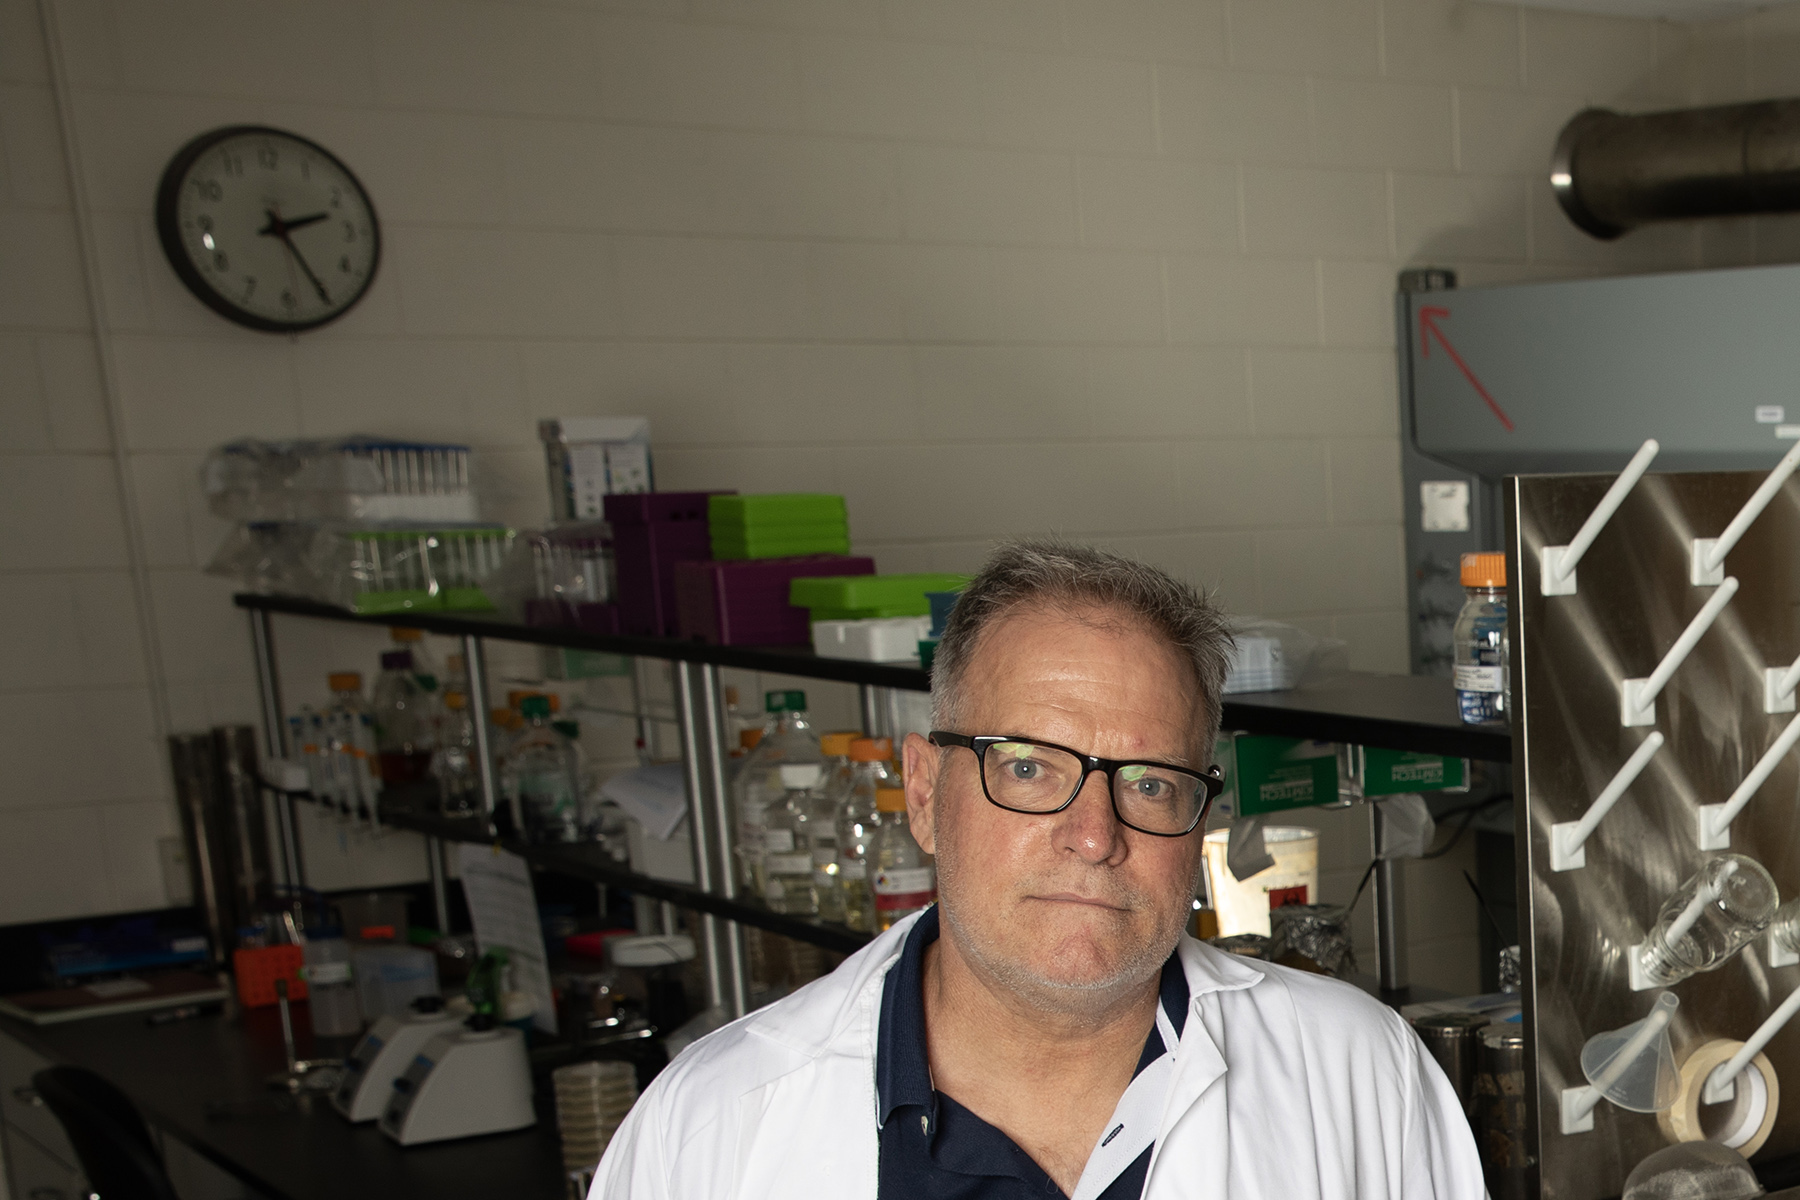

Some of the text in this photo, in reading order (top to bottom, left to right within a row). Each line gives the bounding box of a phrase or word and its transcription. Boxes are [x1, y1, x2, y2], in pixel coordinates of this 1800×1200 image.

[222, 149, 243, 176] 11
[257, 147, 278, 170] 12
[301, 160, 310, 180] 1
[193, 179, 223, 202] 10
[331, 187, 341, 208] 2
[198, 214, 213, 233] 9
[342, 220, 356, 242] 3
[213, 250, 229, 272] 8
[338, 254, 351, 272] 4
[242, 275, 257, 304] 7
[281, 288, 297, 308] 6
[1391, 768, 1443, 782] KIMTECH
[1260, 786, 1313, 802] KIMTECH
